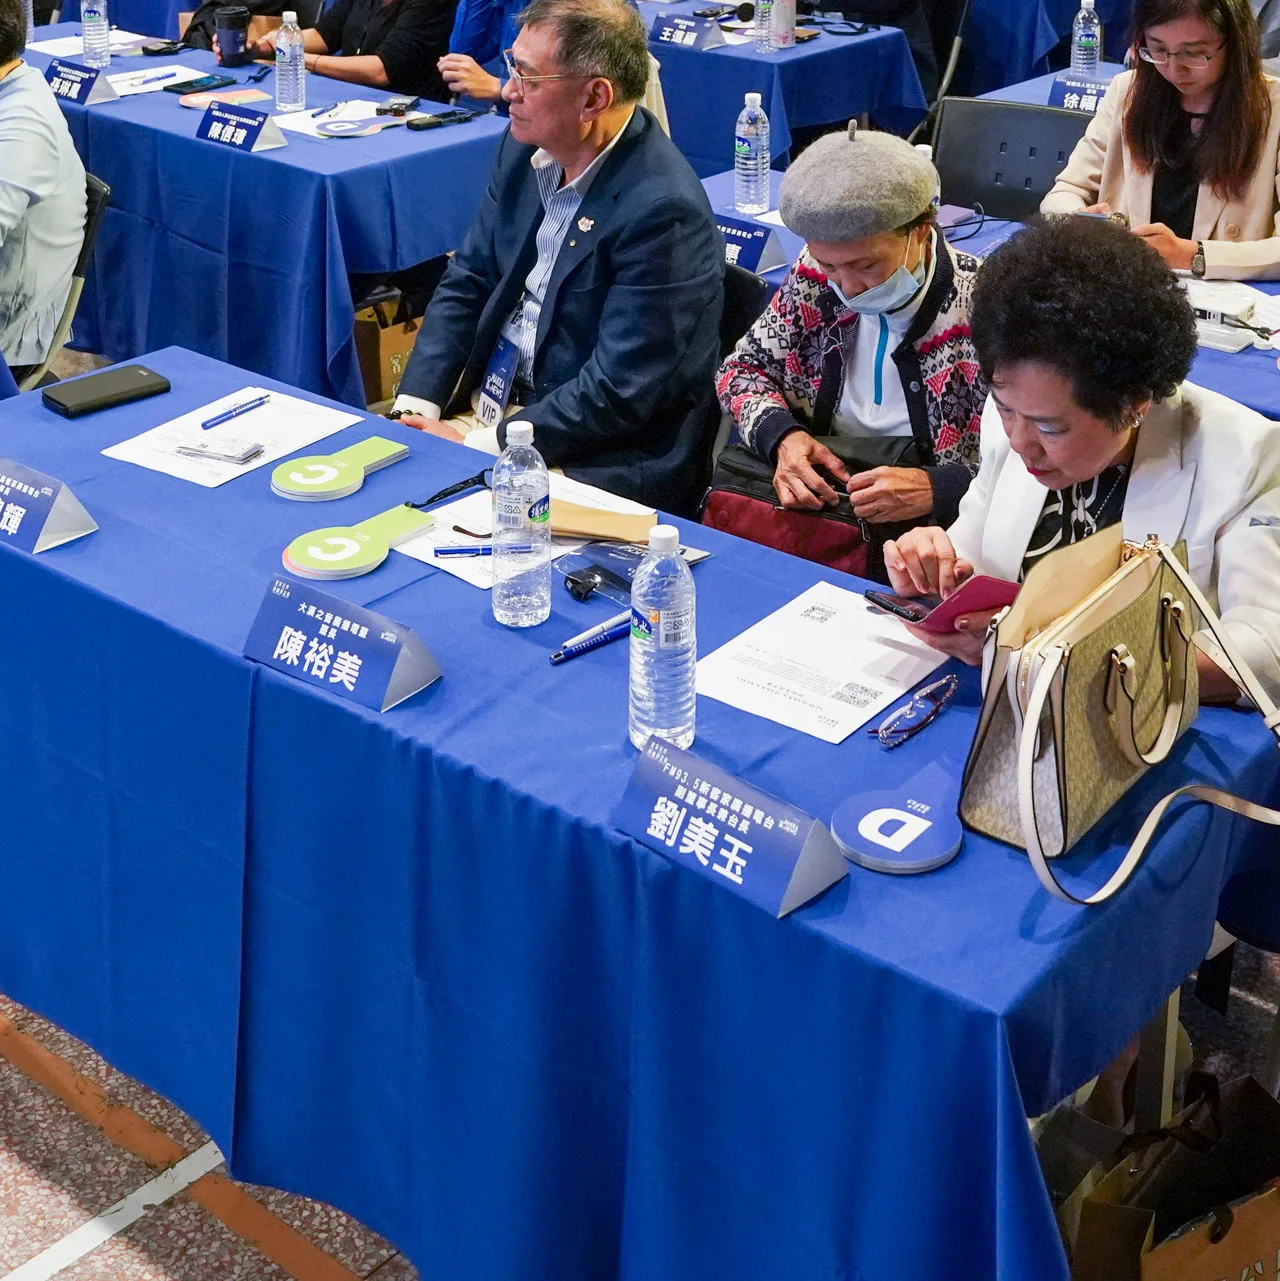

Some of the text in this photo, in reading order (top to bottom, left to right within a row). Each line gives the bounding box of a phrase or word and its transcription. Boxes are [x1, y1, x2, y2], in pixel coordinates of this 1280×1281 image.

[483, 401, 496, 423] VIP
[273, 625, 363, 692] 陳裕美
[647, 796, 753, 885] 劉美玉
[858, 808, 933, 853] D
